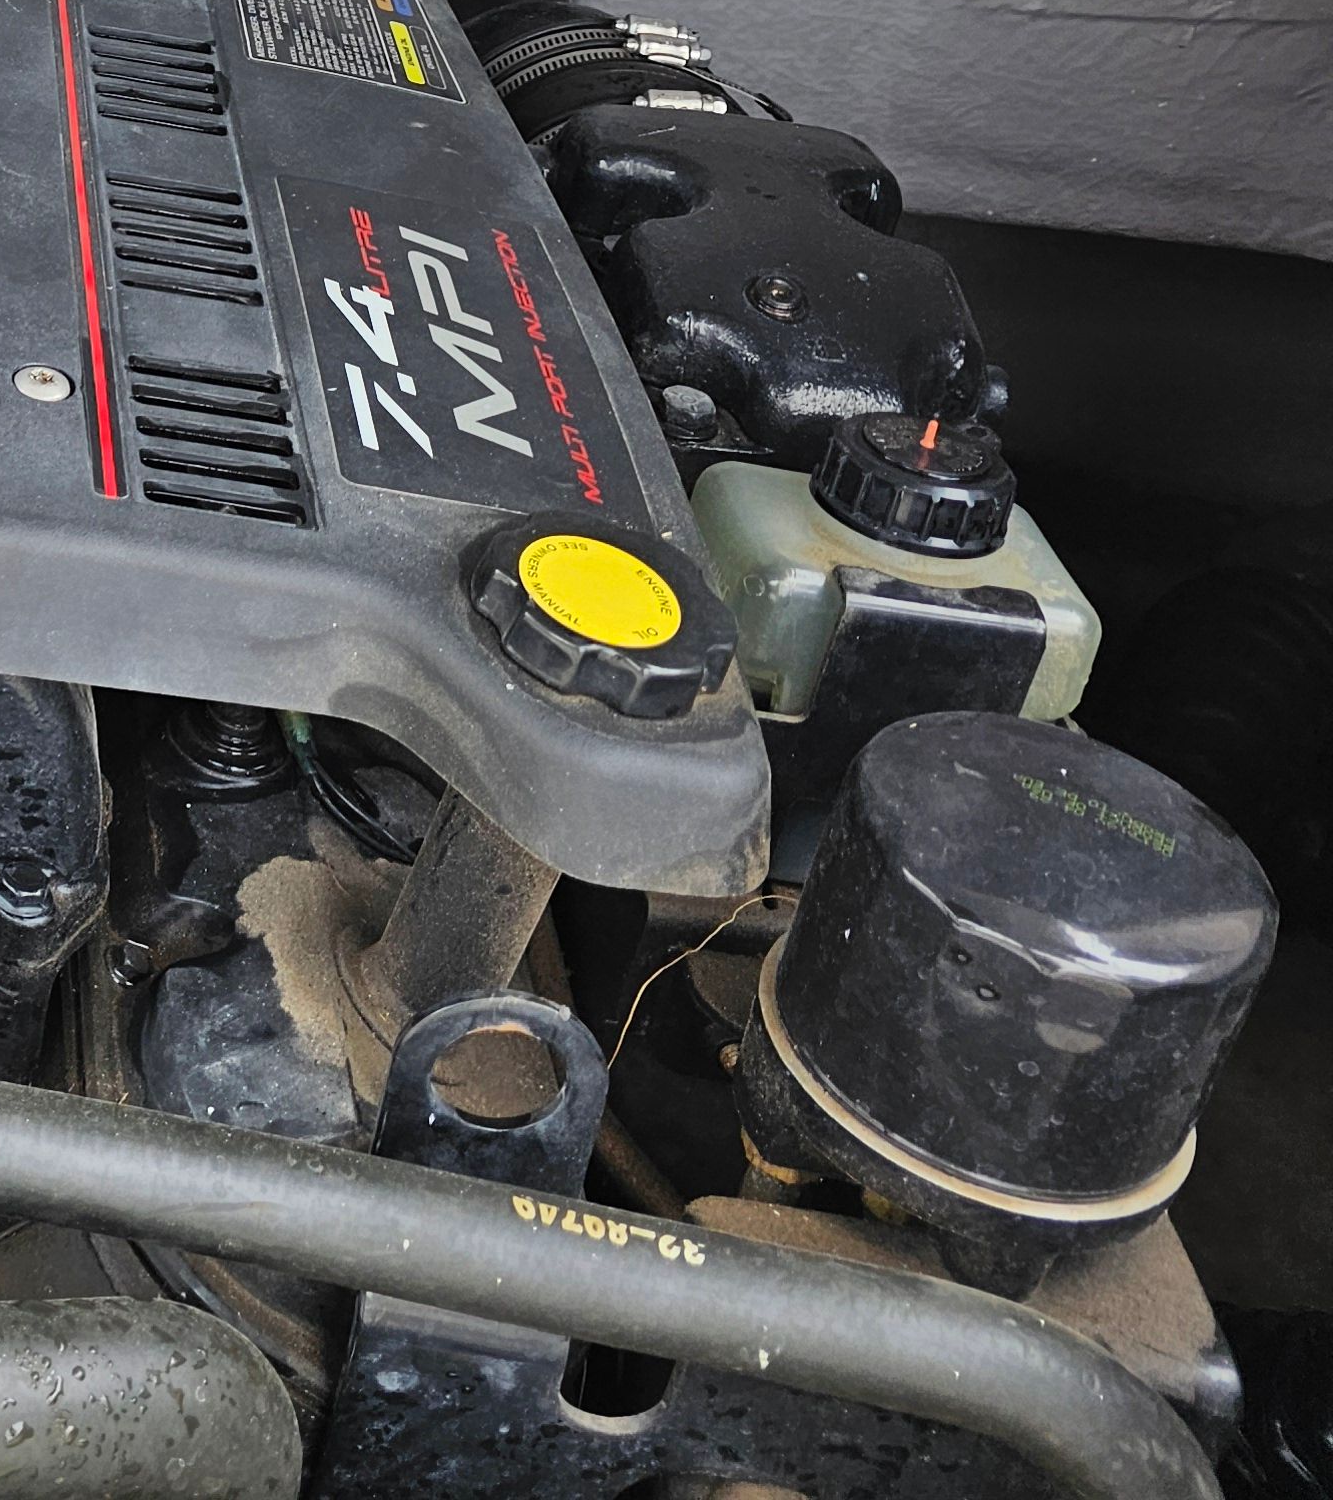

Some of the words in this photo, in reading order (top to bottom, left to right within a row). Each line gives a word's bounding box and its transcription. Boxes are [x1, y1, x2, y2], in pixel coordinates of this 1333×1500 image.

[384, 31, 394, 45] CODE
[389, 47, 400, 64] COLOR
[348, 205, 391, 299] LITRE
[491, 227, 549, 344] INJECTION
[398, 225, 534, 459] MPI
[323, 277, 434, 460] 7.4
[533, 343, 575, 422] PORT
[559, 423, 604, 506] MULTI
[526, 542, 559, 580] OWNERS
[558, 541, 589, 552] SEE
[530, 580, 583, 627] MANUAL
[636, 568, 673, 617] ENGINE
[631, 627, 659, 642] OIL
